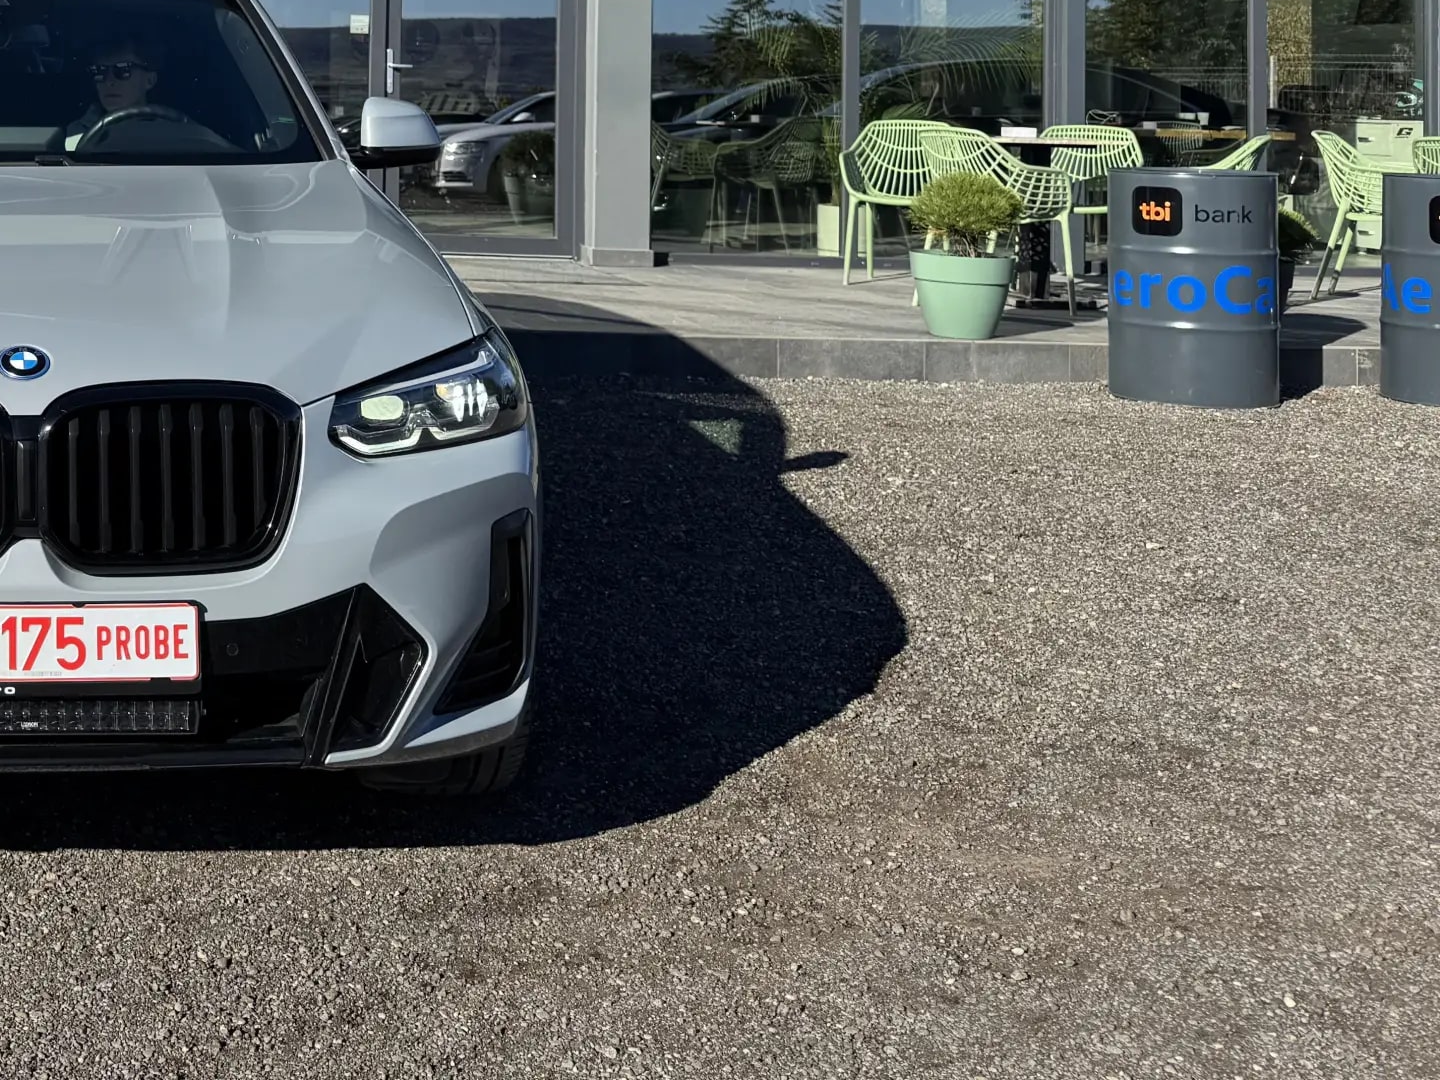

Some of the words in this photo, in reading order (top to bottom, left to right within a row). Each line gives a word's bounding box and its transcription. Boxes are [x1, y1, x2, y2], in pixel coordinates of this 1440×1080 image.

[1139, 201, 1171, 222] tbi
[1194, 204, 1252, 224] bank
[1109, 265, 1275, 314] eroCa
[1, 616, 87, 671] 175
[97, 624, 189, 661] PROBE
